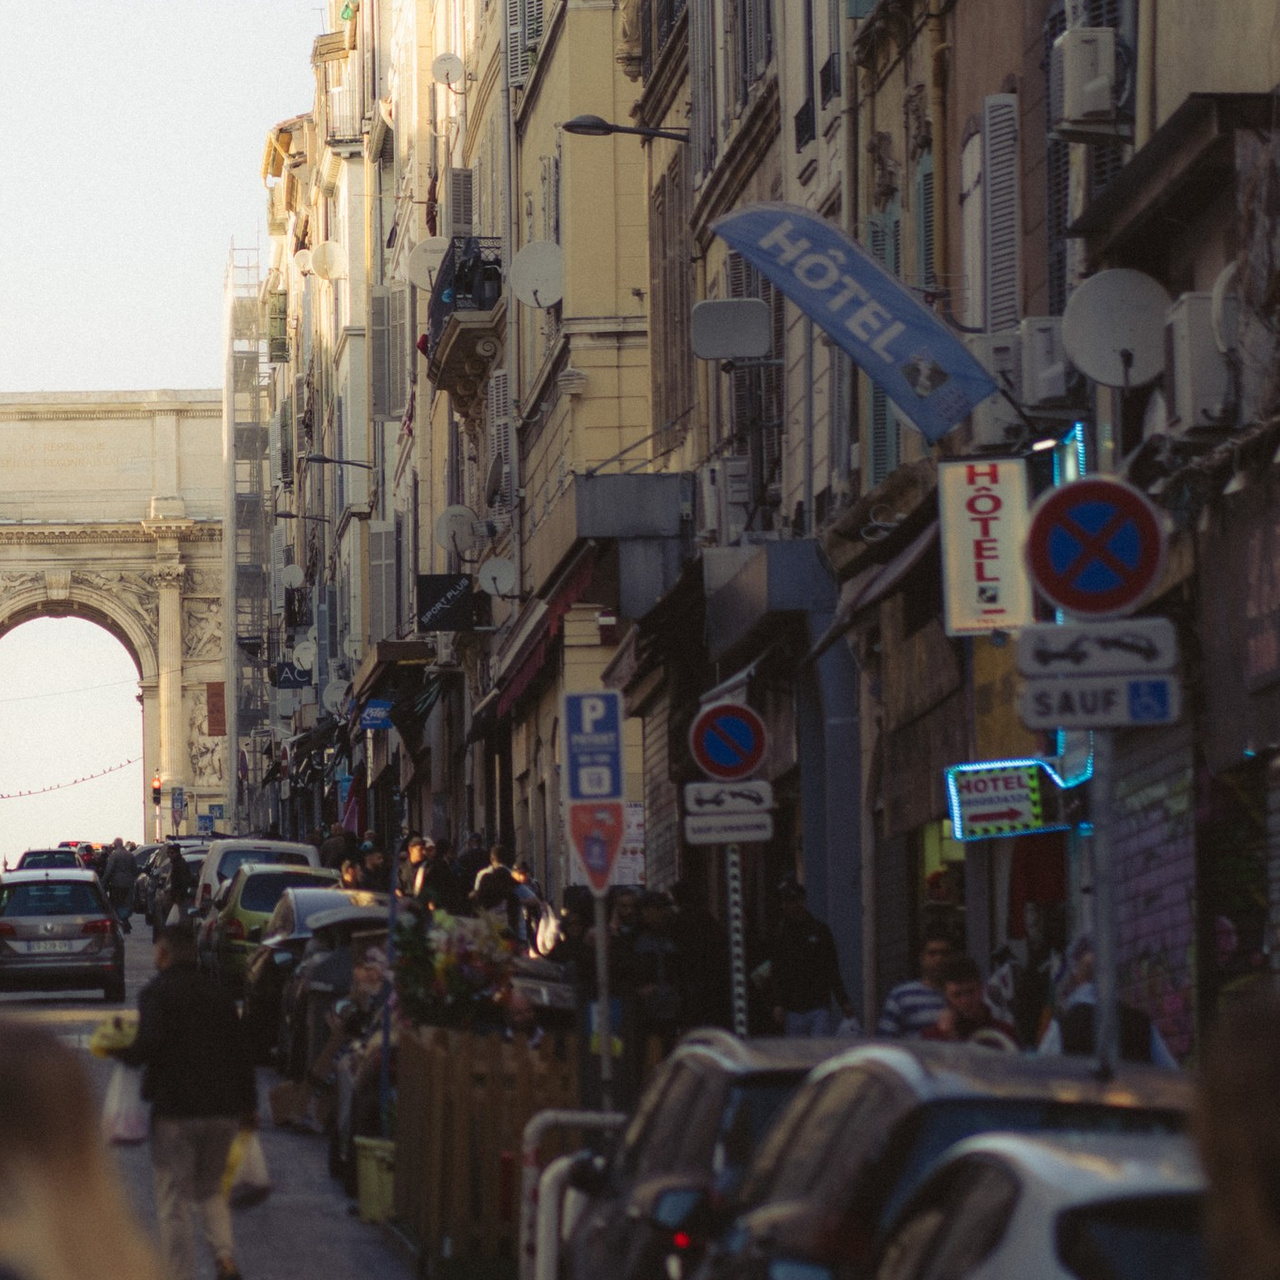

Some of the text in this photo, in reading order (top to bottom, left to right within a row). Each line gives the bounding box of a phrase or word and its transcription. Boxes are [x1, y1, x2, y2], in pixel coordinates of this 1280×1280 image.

[759, 220, 907, 364] HÔTEL
[965, 464, 1003, 581] HÔTEL
[445, 577, 470, 600] PLUS
[580, 697, 606, 732] P
[1033, 688, 1118, 717] SAUF
[958, 775, 1029, 794] HOTEL
